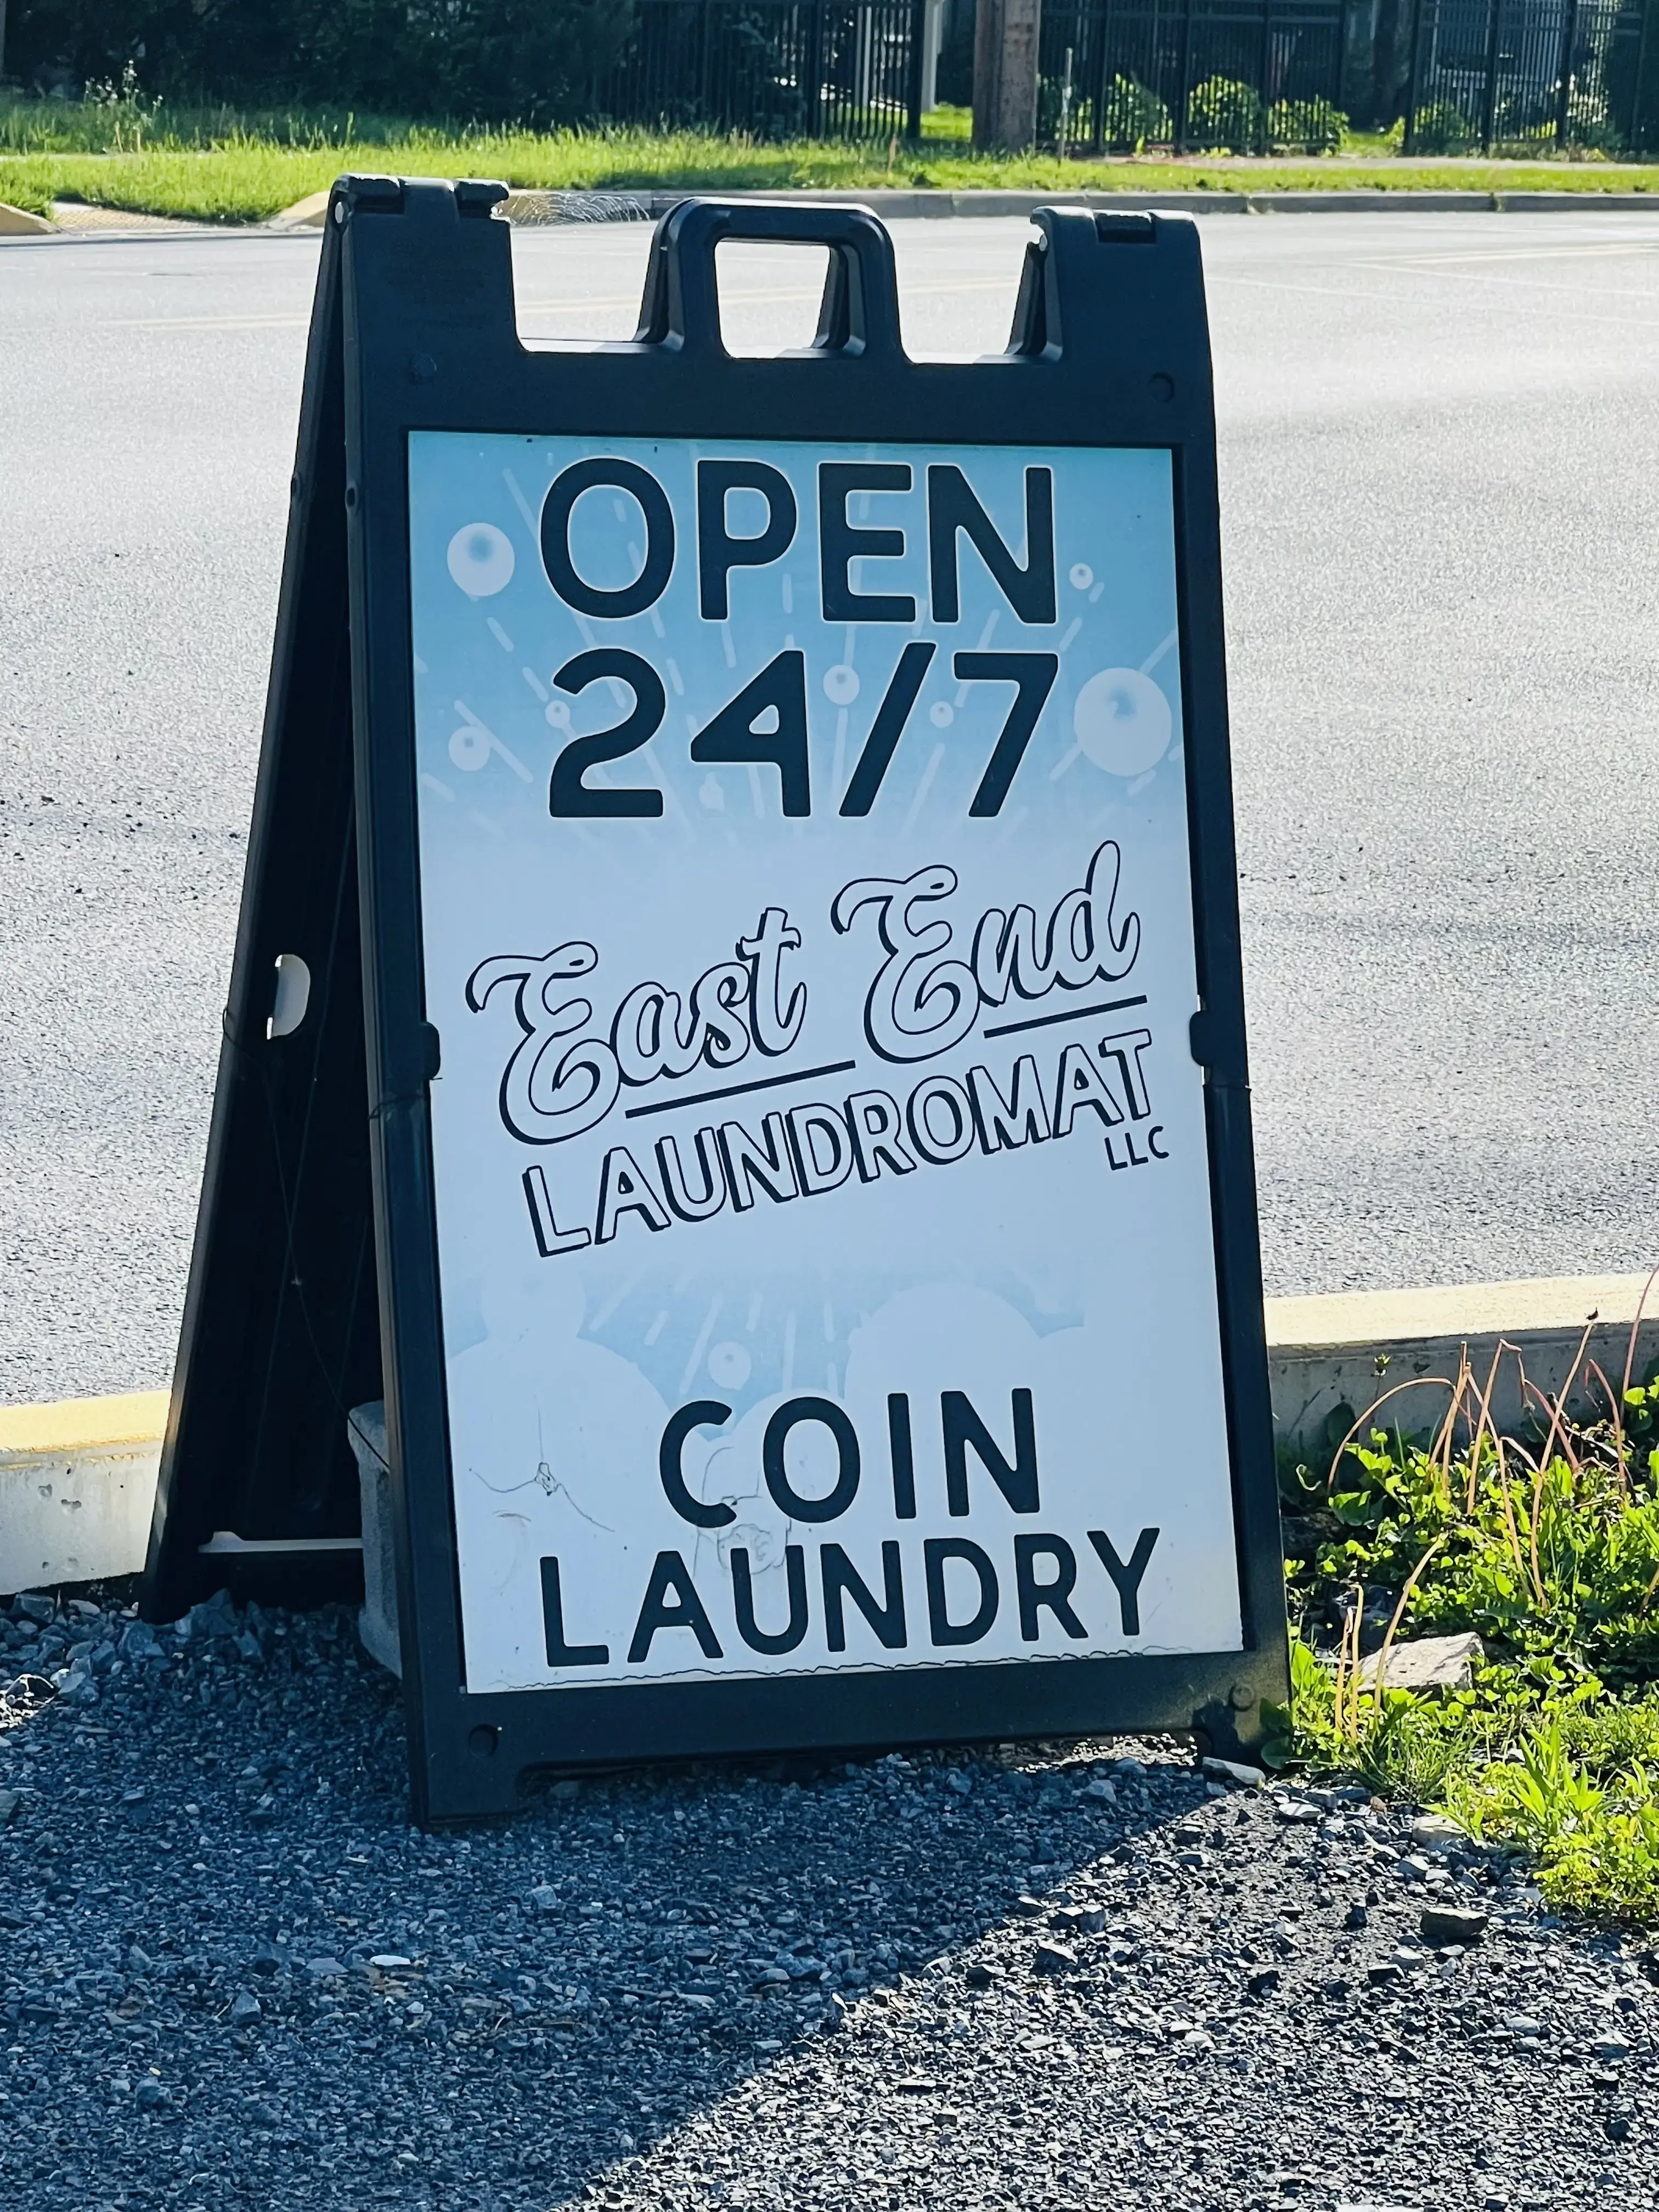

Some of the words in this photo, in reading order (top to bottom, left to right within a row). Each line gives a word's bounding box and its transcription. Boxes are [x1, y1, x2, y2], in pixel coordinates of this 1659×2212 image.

[540, 458, 1056, 624] OPEN
[549, 642, 1058, 818] 24/7
[465, 907, 807, 1146] East
[830, 840, 1141, 1064] End
[522, 1028, 1152, 1258] LAUNDROMAT
[1104, 1126, 1170, 1171] LLC
[659, 1387, 1040, 1528] COIN
[539, 1527, 1160, 1667] LAUNDRY
